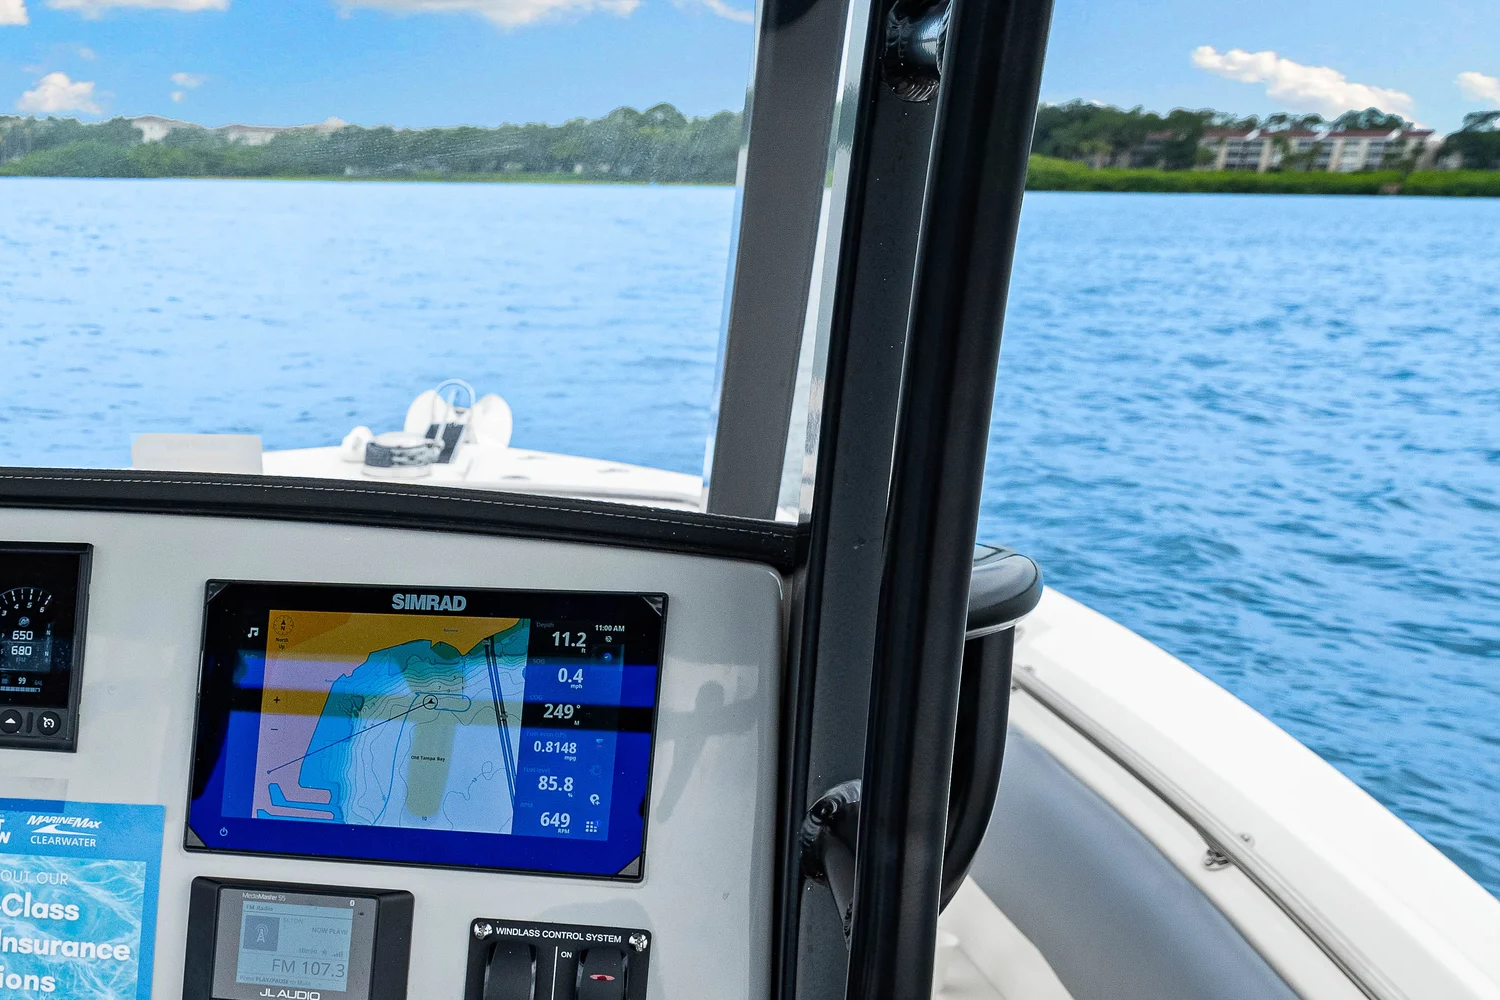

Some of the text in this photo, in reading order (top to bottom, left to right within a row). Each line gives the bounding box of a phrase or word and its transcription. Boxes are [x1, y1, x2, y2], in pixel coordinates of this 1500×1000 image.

[392, 594, 467, 612] SIMRAD
[12, 631, 33, 640] 650
[552, 631, 587, 647] 11.2
[11, 646, 32, 656] 680
[558, 667, 583, 683] 0.4
[534, 741, 577, 754] 0.8148
[538, 776, 573, 791] 85.8
[540, 812, 570, 827] 649
[30, 836, 96, 847] CLEARWATER
[36, 872, 69, 886] OUR
[242, 892, 277, 900] MediaMaster
[496, 927, 622, 943] WINDLASS CONTROL SYSTEM
[272, 959, 345, 978] FM 107.3
[260, 988, 320, 1000] JL AUDIO
